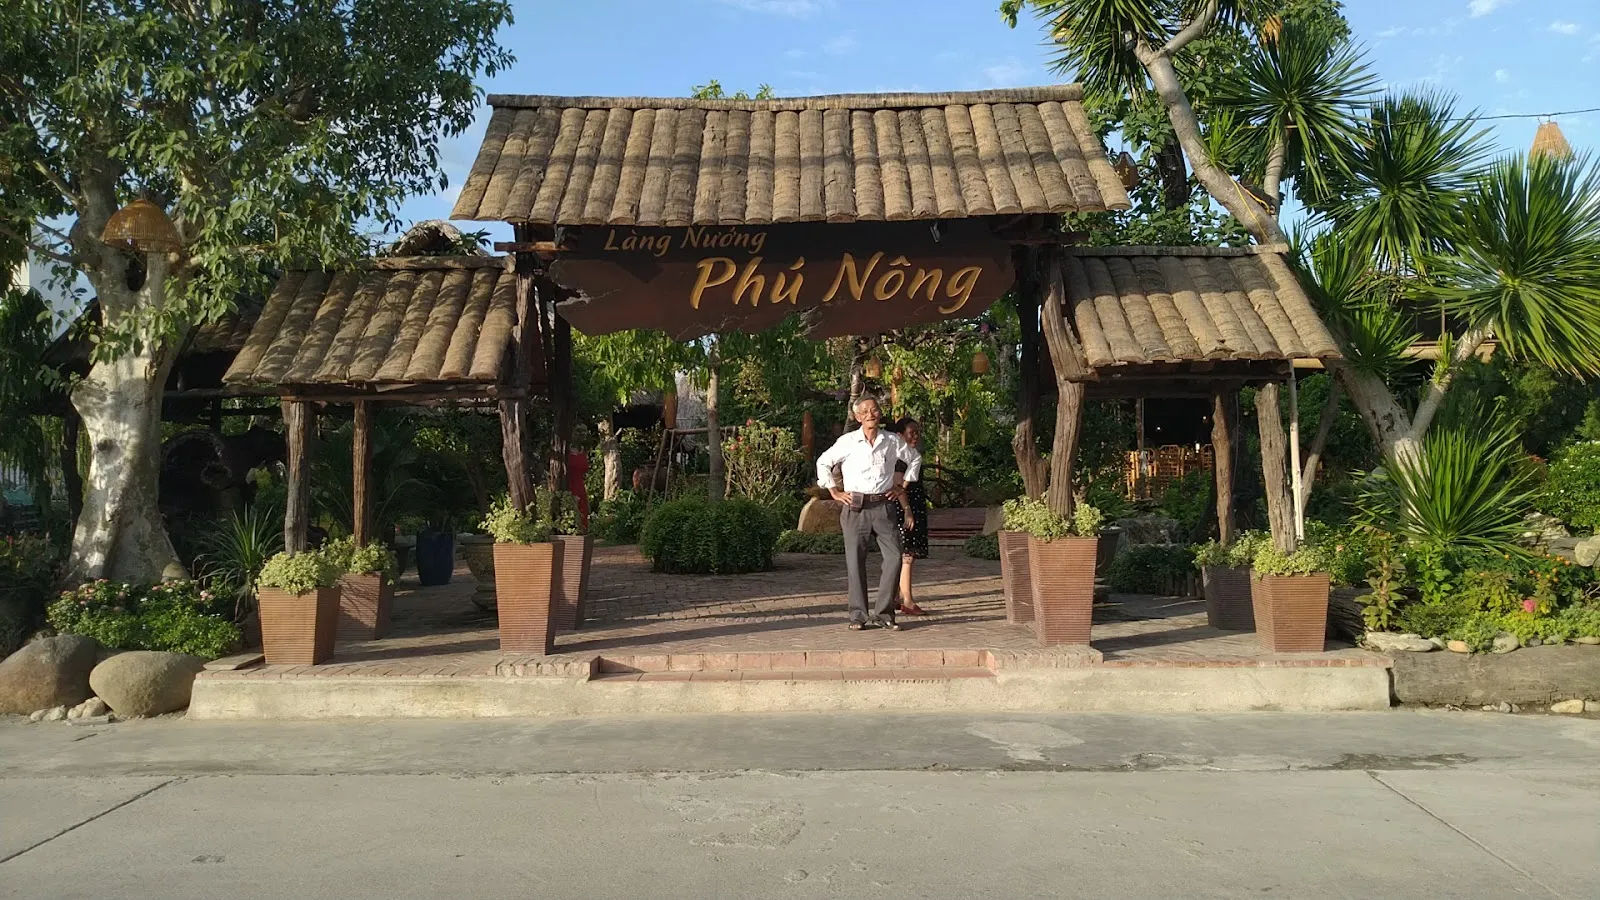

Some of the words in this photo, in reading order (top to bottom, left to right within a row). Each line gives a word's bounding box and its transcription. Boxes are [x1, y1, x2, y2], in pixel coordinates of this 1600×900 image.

[603, 228, 672, 257] Làng
[680, 226, 767, 254] Nướng
[692, 256, 804, 309] Phú
[823, 252, 982, 314] Nông
